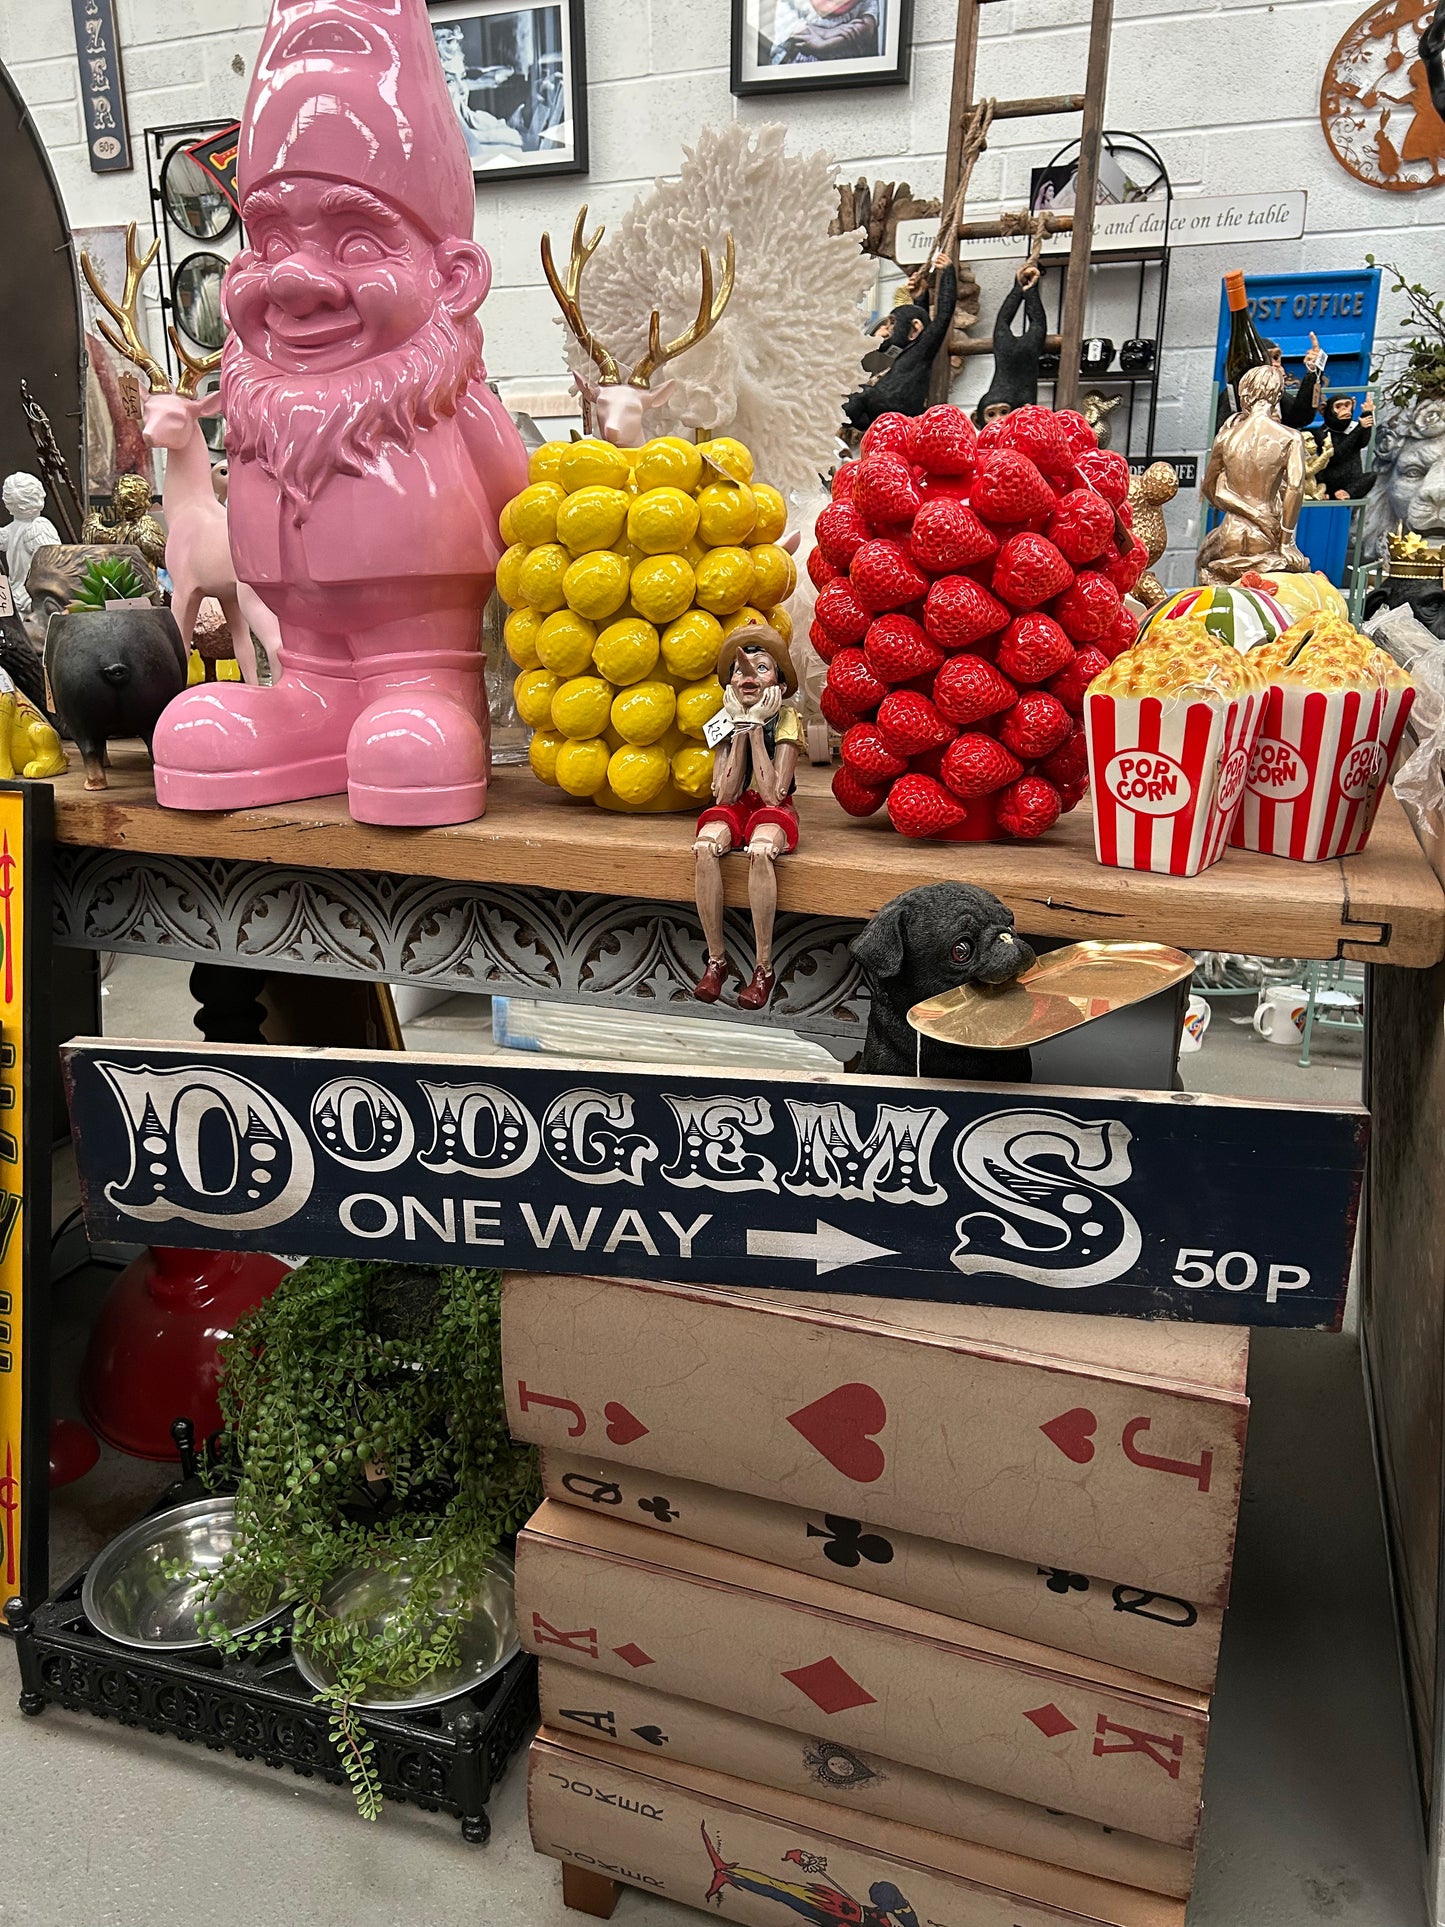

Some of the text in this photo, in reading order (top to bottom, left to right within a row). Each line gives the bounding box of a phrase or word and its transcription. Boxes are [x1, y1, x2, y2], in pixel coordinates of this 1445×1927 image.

[908, 230, 936, 249] Tim
[1104, 213, 1140, 236] and
[1139, 212, 1186, 234] dance
[1191, 213, 1211, 229] on
[1217, 206, 1243, 226] the
[1248, 203, 1290, 225] table
[1247, 291, 1365, 320] OST OFFICE
[1116, 775, 1178, 802] CORN
[1118, 758, 1170, 781] POP
[1225, 755, 1244, 783] POP
[93, 1060, 1142, 1288] DODGEMS
[338, 1192, 714, 1259] ONE WAY
[517, 1379, 587, 1438] J
[1121, 1416, 1213, 1492] J
[532, 1612, 600, 1660] K
[558, 1707, 618, 1738] A
[1092, 1713, 1185, 1780] K
[548, 1772, 664, 1822] JOKER
[550, 1842, 666, 1890] JOKER
